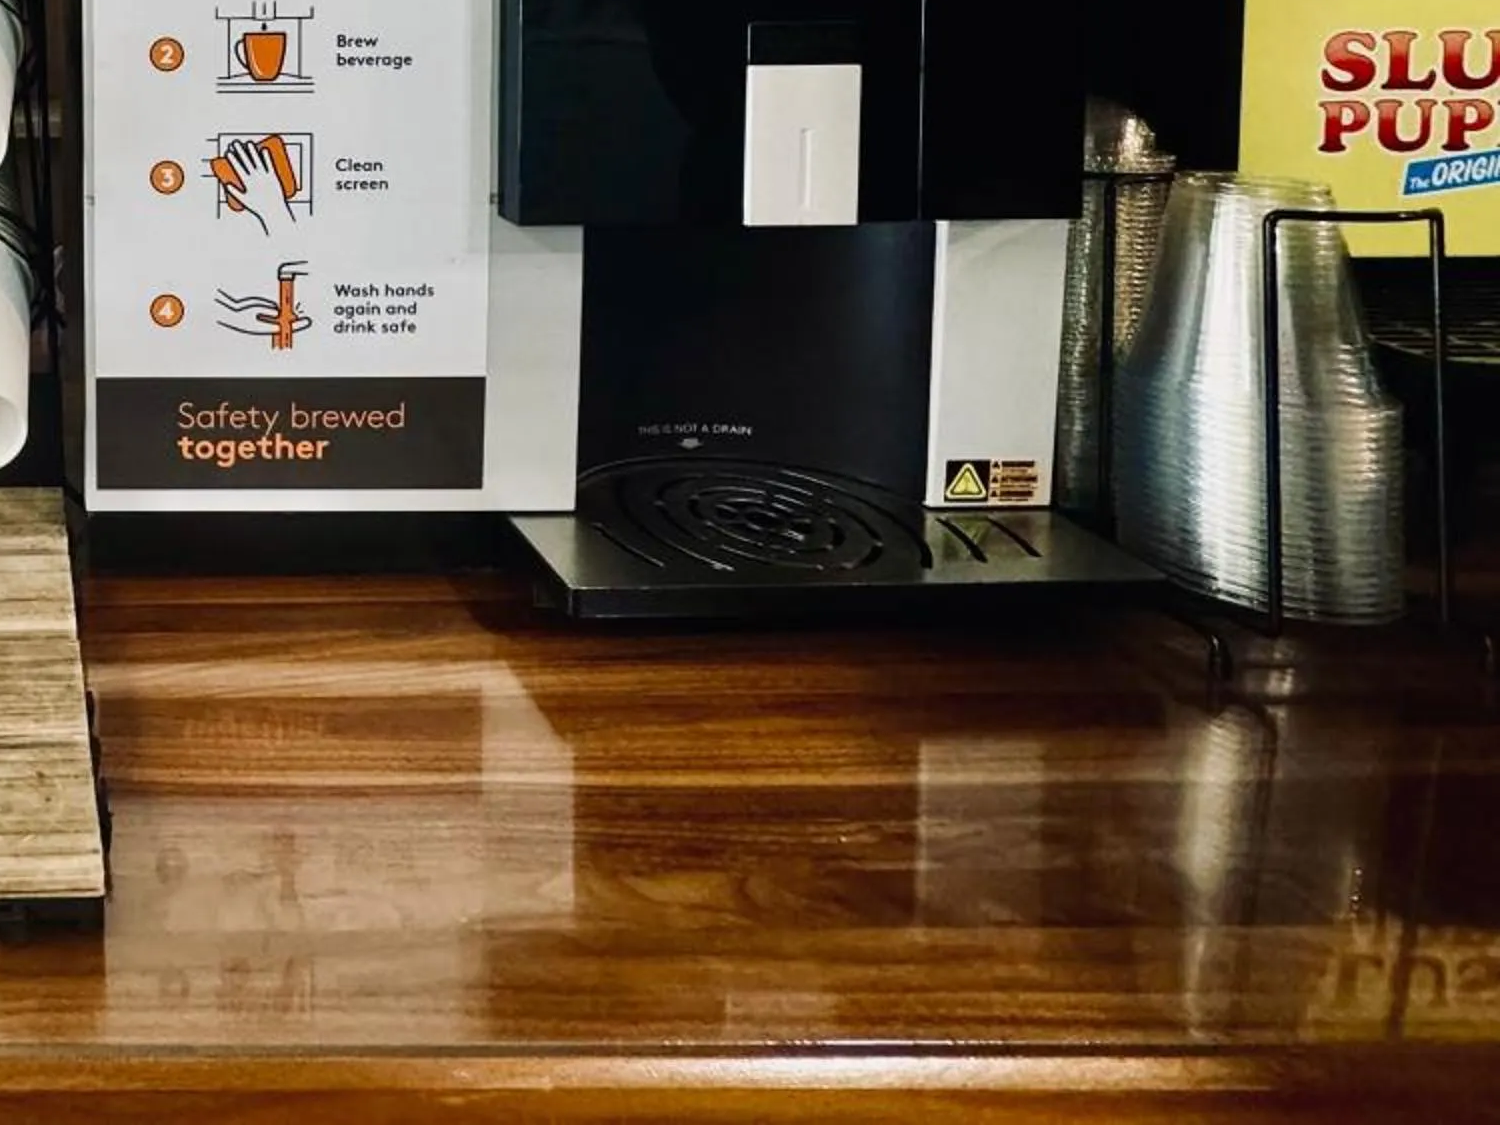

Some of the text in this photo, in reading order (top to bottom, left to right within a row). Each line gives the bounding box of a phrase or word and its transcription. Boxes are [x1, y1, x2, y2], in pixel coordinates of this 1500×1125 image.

[337, 35, 378, 48] Brew
[336, 53, 412, 70] beverage
[1321, 30, 1500, 91] SLU
[1318, 99, 1500, 153] PUP
[335, 158, 382, 172] Clean
[335, 178, 388, 191] screen
[334, 283, 435, 297] Wash hands
[334, 302, 417, 317] again and
[334, 319, 416, 333] drink safe
[178, 402, 405, 435] Safety brewed
[674, 423, 698, 433] NOT
[713, 423, 752, 435] DRAIN
[178, 433, 329, 467] together
